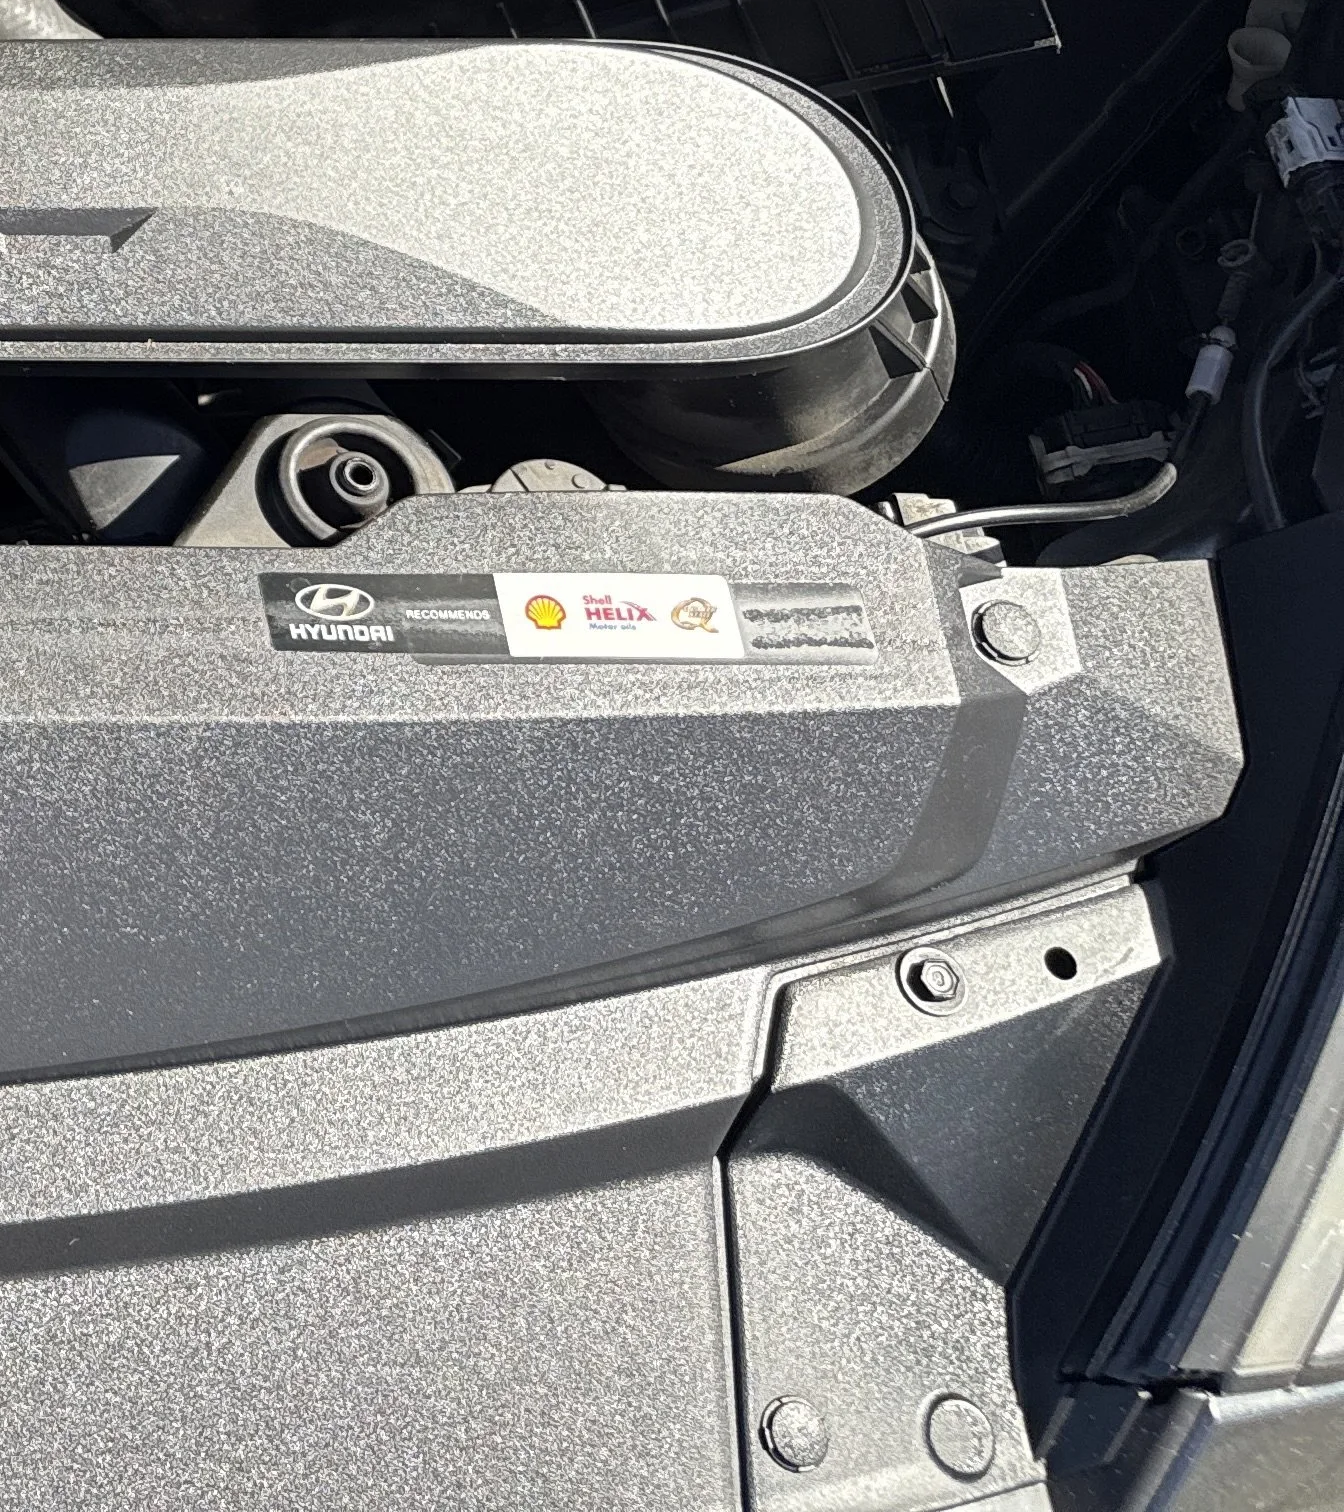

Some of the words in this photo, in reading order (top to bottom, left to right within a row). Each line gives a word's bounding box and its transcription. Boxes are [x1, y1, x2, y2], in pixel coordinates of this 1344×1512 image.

[582, 595, 612, 605] Shell
[584, 603, 657, 621] HELIX
[288, 623, 396, 642] HYUNDAI
[404, 609, 490, 621] RECOMMENDS
[589, 622, 617, 630] Motor
